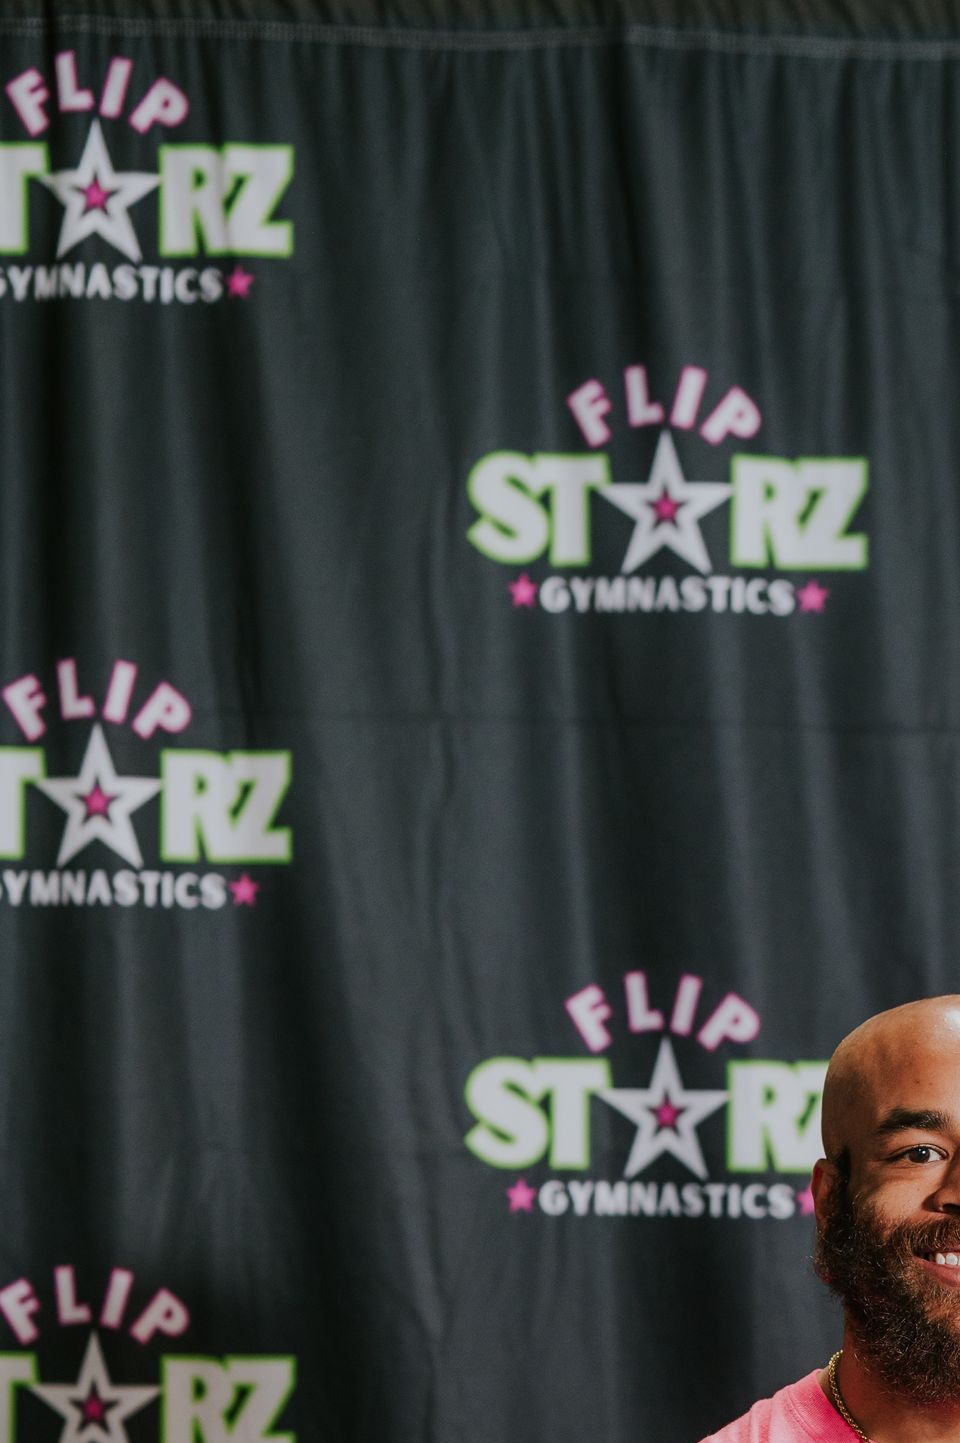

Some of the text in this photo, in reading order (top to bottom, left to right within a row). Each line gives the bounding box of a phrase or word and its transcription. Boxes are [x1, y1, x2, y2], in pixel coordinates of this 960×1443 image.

[6, 51, 189, 137] FLIP
[0, 263, 224, 304] YMNASTICS
[567, 365, 762, 448] FLIP
[538, 575, 797, 617] GYMNASTICS
[2, 658, 193, 741] FLIP
[0, 868, 228, 910] YMNASTICS
[564, 970, 762, 1053] FLIP
[538, 1180, 797, 1221] GYMNASTICS
[0, 1264, 191, 1346] FLIP
